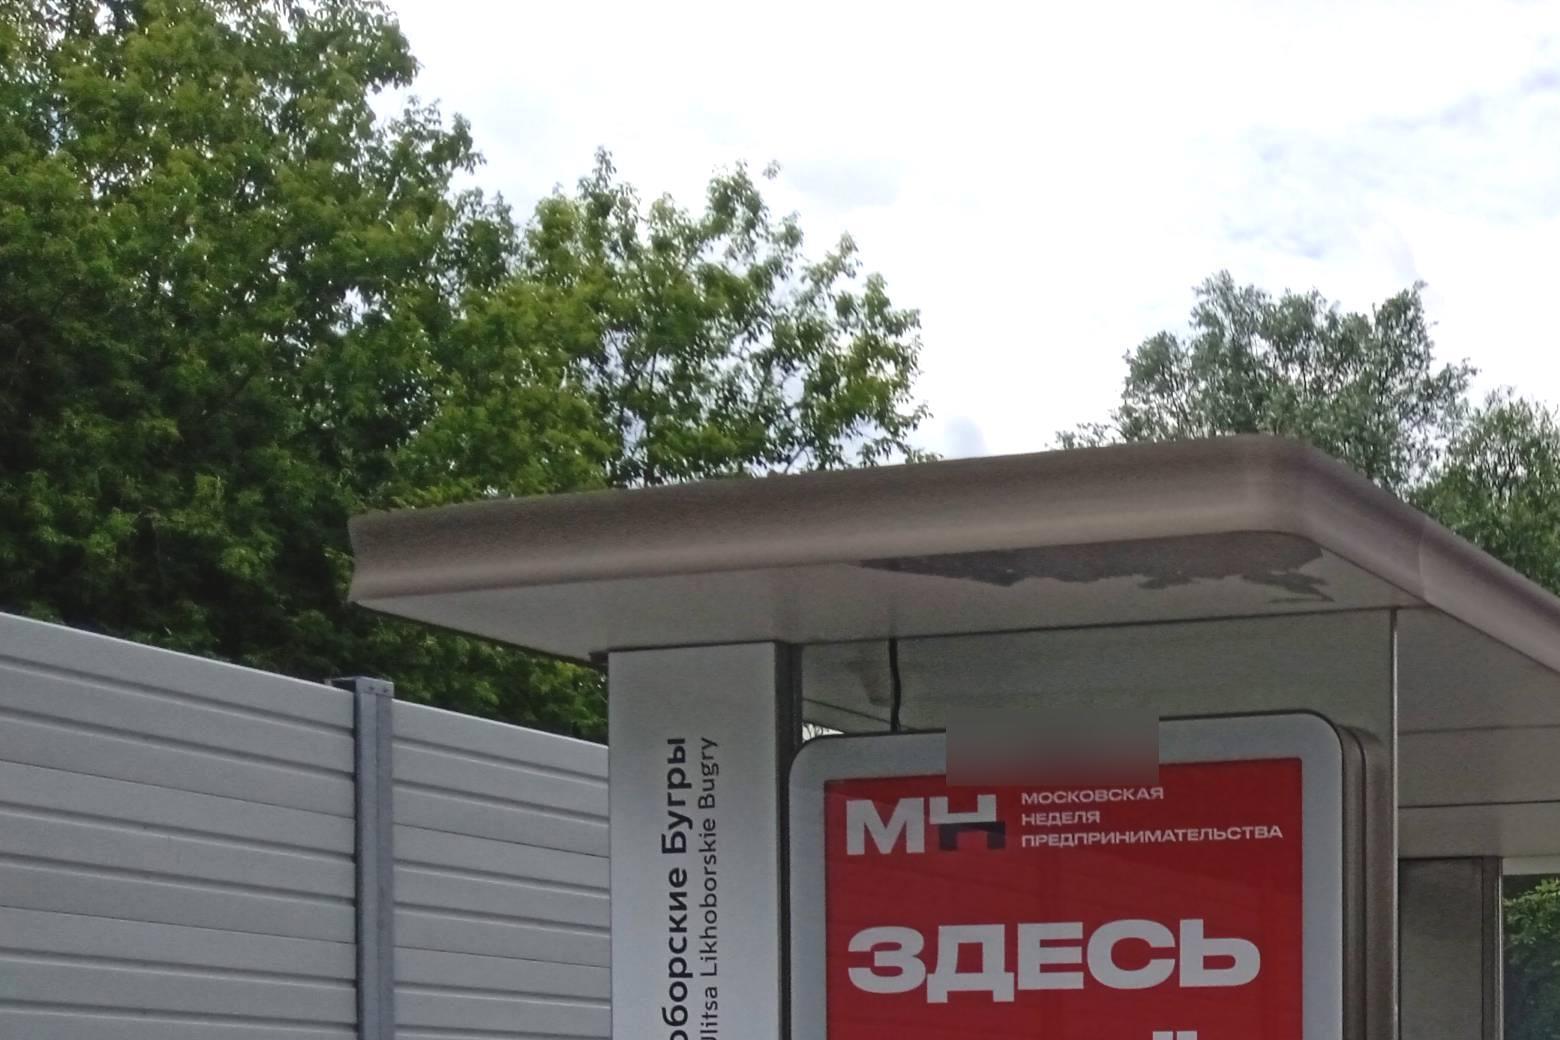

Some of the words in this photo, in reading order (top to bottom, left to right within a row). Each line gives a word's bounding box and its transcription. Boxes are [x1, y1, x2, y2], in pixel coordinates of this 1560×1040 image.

[661, 738, 693, 854] Бугры
[698, 737, 719, 809] Bugry
[1021, 787, 1165, 806] МОСКОВСКАЯ
[1021, 809, 1101, 827] НЕДЕЛЯ
[1021, 825, 1284, 848] ПРЕДПРИНИМАТЕЛЬСТВА
[699, 818, 718, 977] Likhoborskie
[847, 918, 1261, 1004] ЗДЕСЬ
